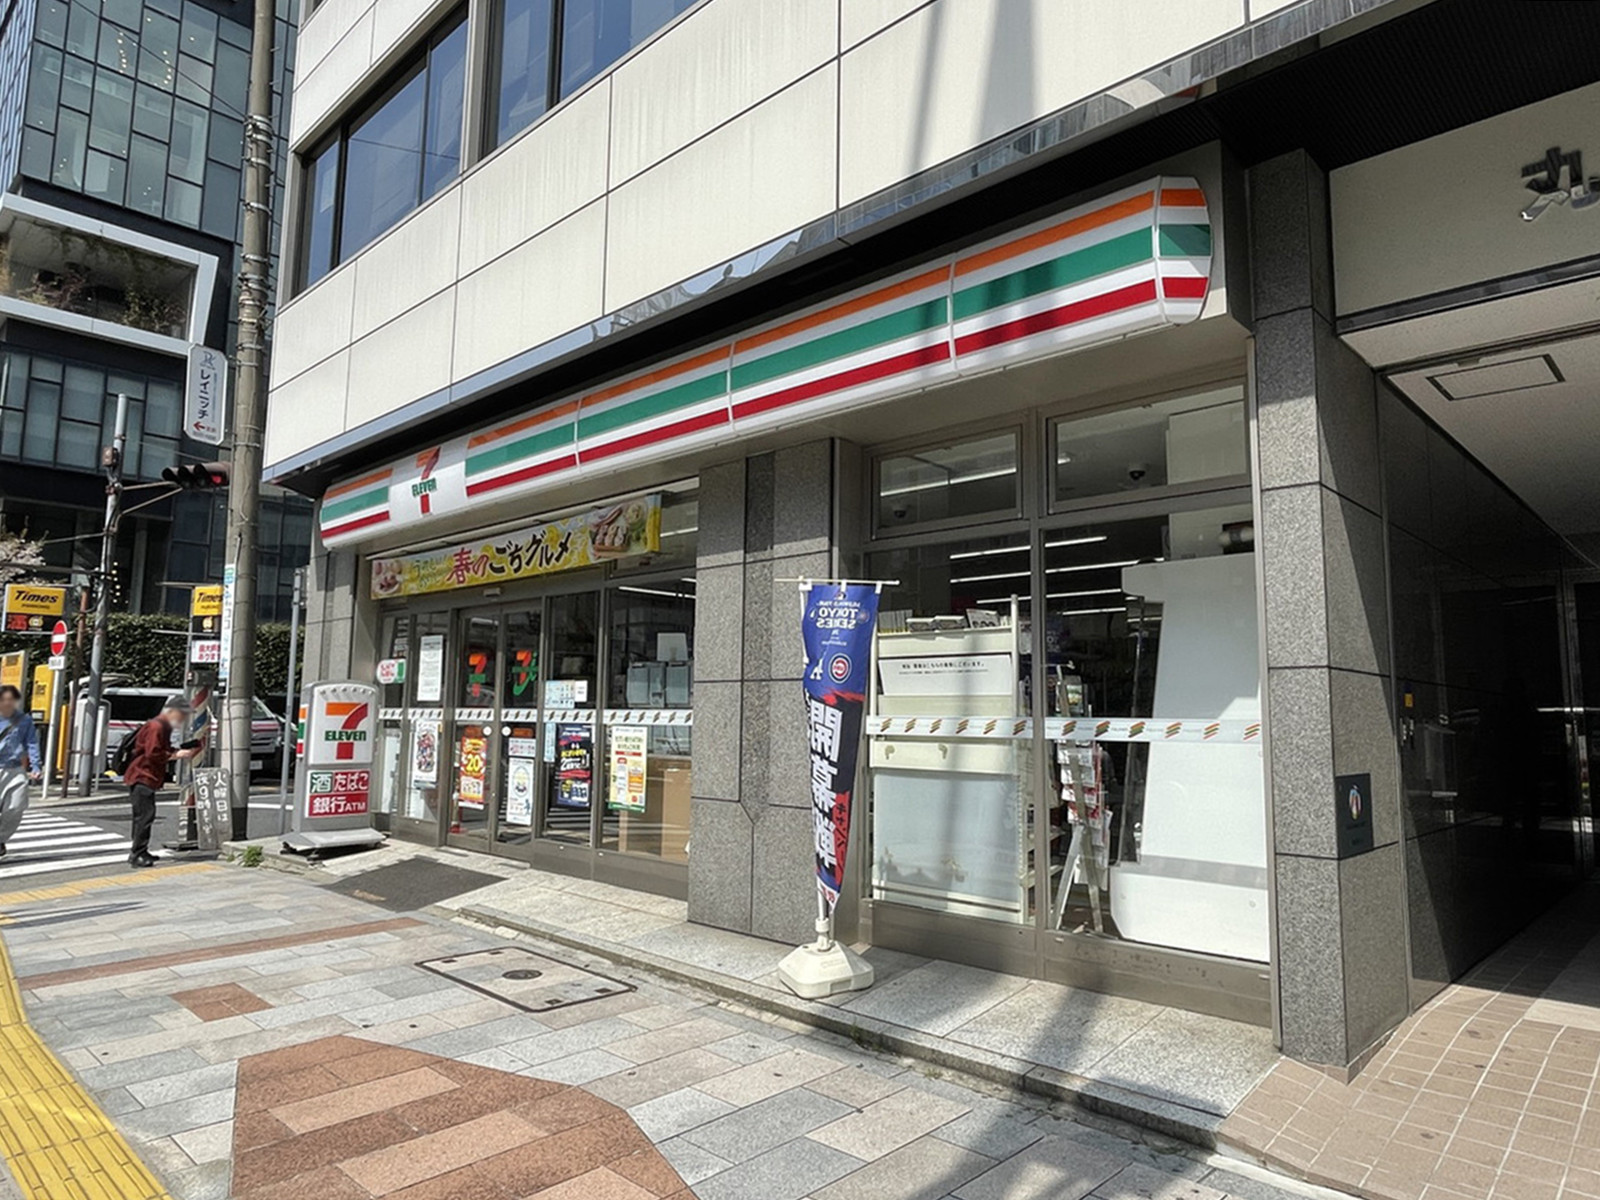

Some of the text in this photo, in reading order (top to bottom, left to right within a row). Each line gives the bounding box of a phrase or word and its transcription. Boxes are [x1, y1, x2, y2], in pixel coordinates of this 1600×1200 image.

[415, 446, 442, 514] 7
[446, 530, 571, 585] 春のごちグルメ
[14, 590, 59, 604] Times
[325, 702, 369, 760] 7
[213, 771, 229, 822] 火曜日は
[311, 773, 369, 793] 酒 たばこ
[312, 795, 366, 815] 銀行ATM
